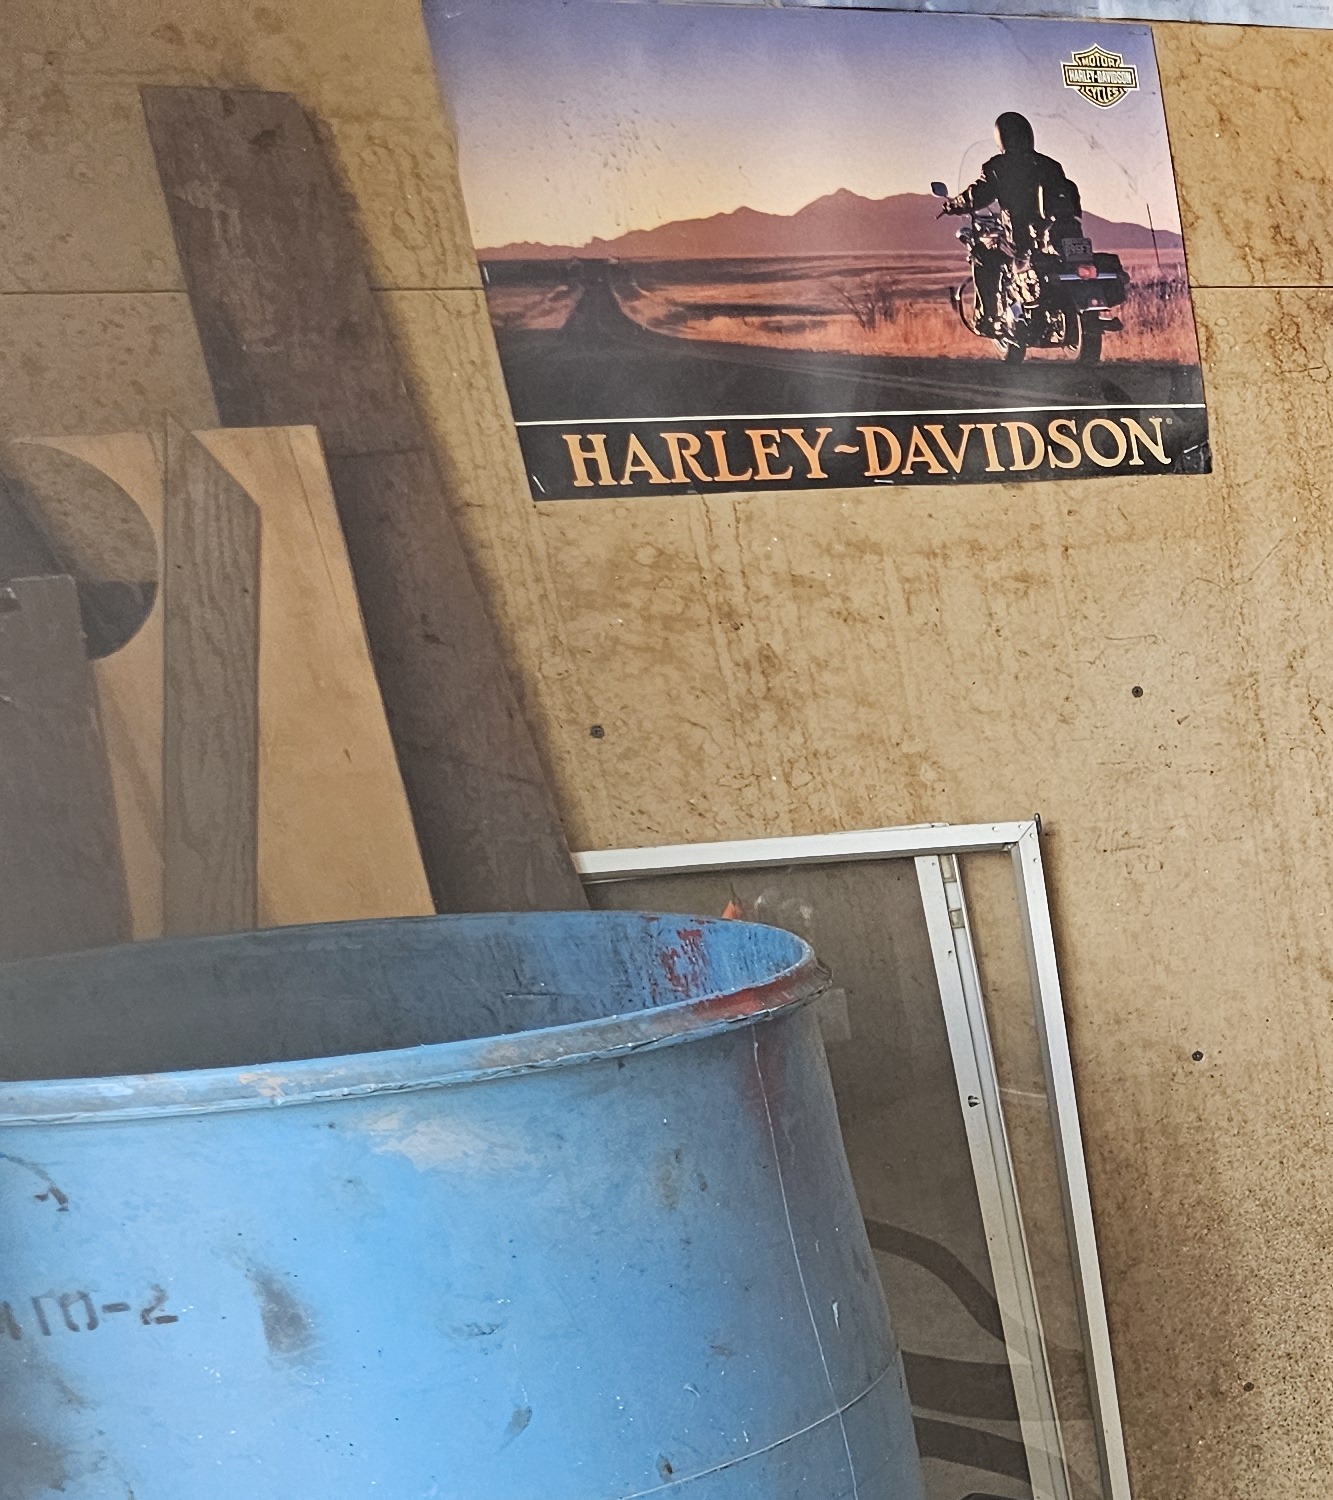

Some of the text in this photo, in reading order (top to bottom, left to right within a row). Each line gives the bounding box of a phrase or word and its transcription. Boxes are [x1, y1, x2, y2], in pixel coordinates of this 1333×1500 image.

[1081, 52, 1119, 67] MOTOR
[1068, 69, 1132, 85] HARLEY-DAVIDSON
[1085, 86, 1120, 103] CYCLES
[562, 416, 1173, 488] HARLEY-DAVIDSON
